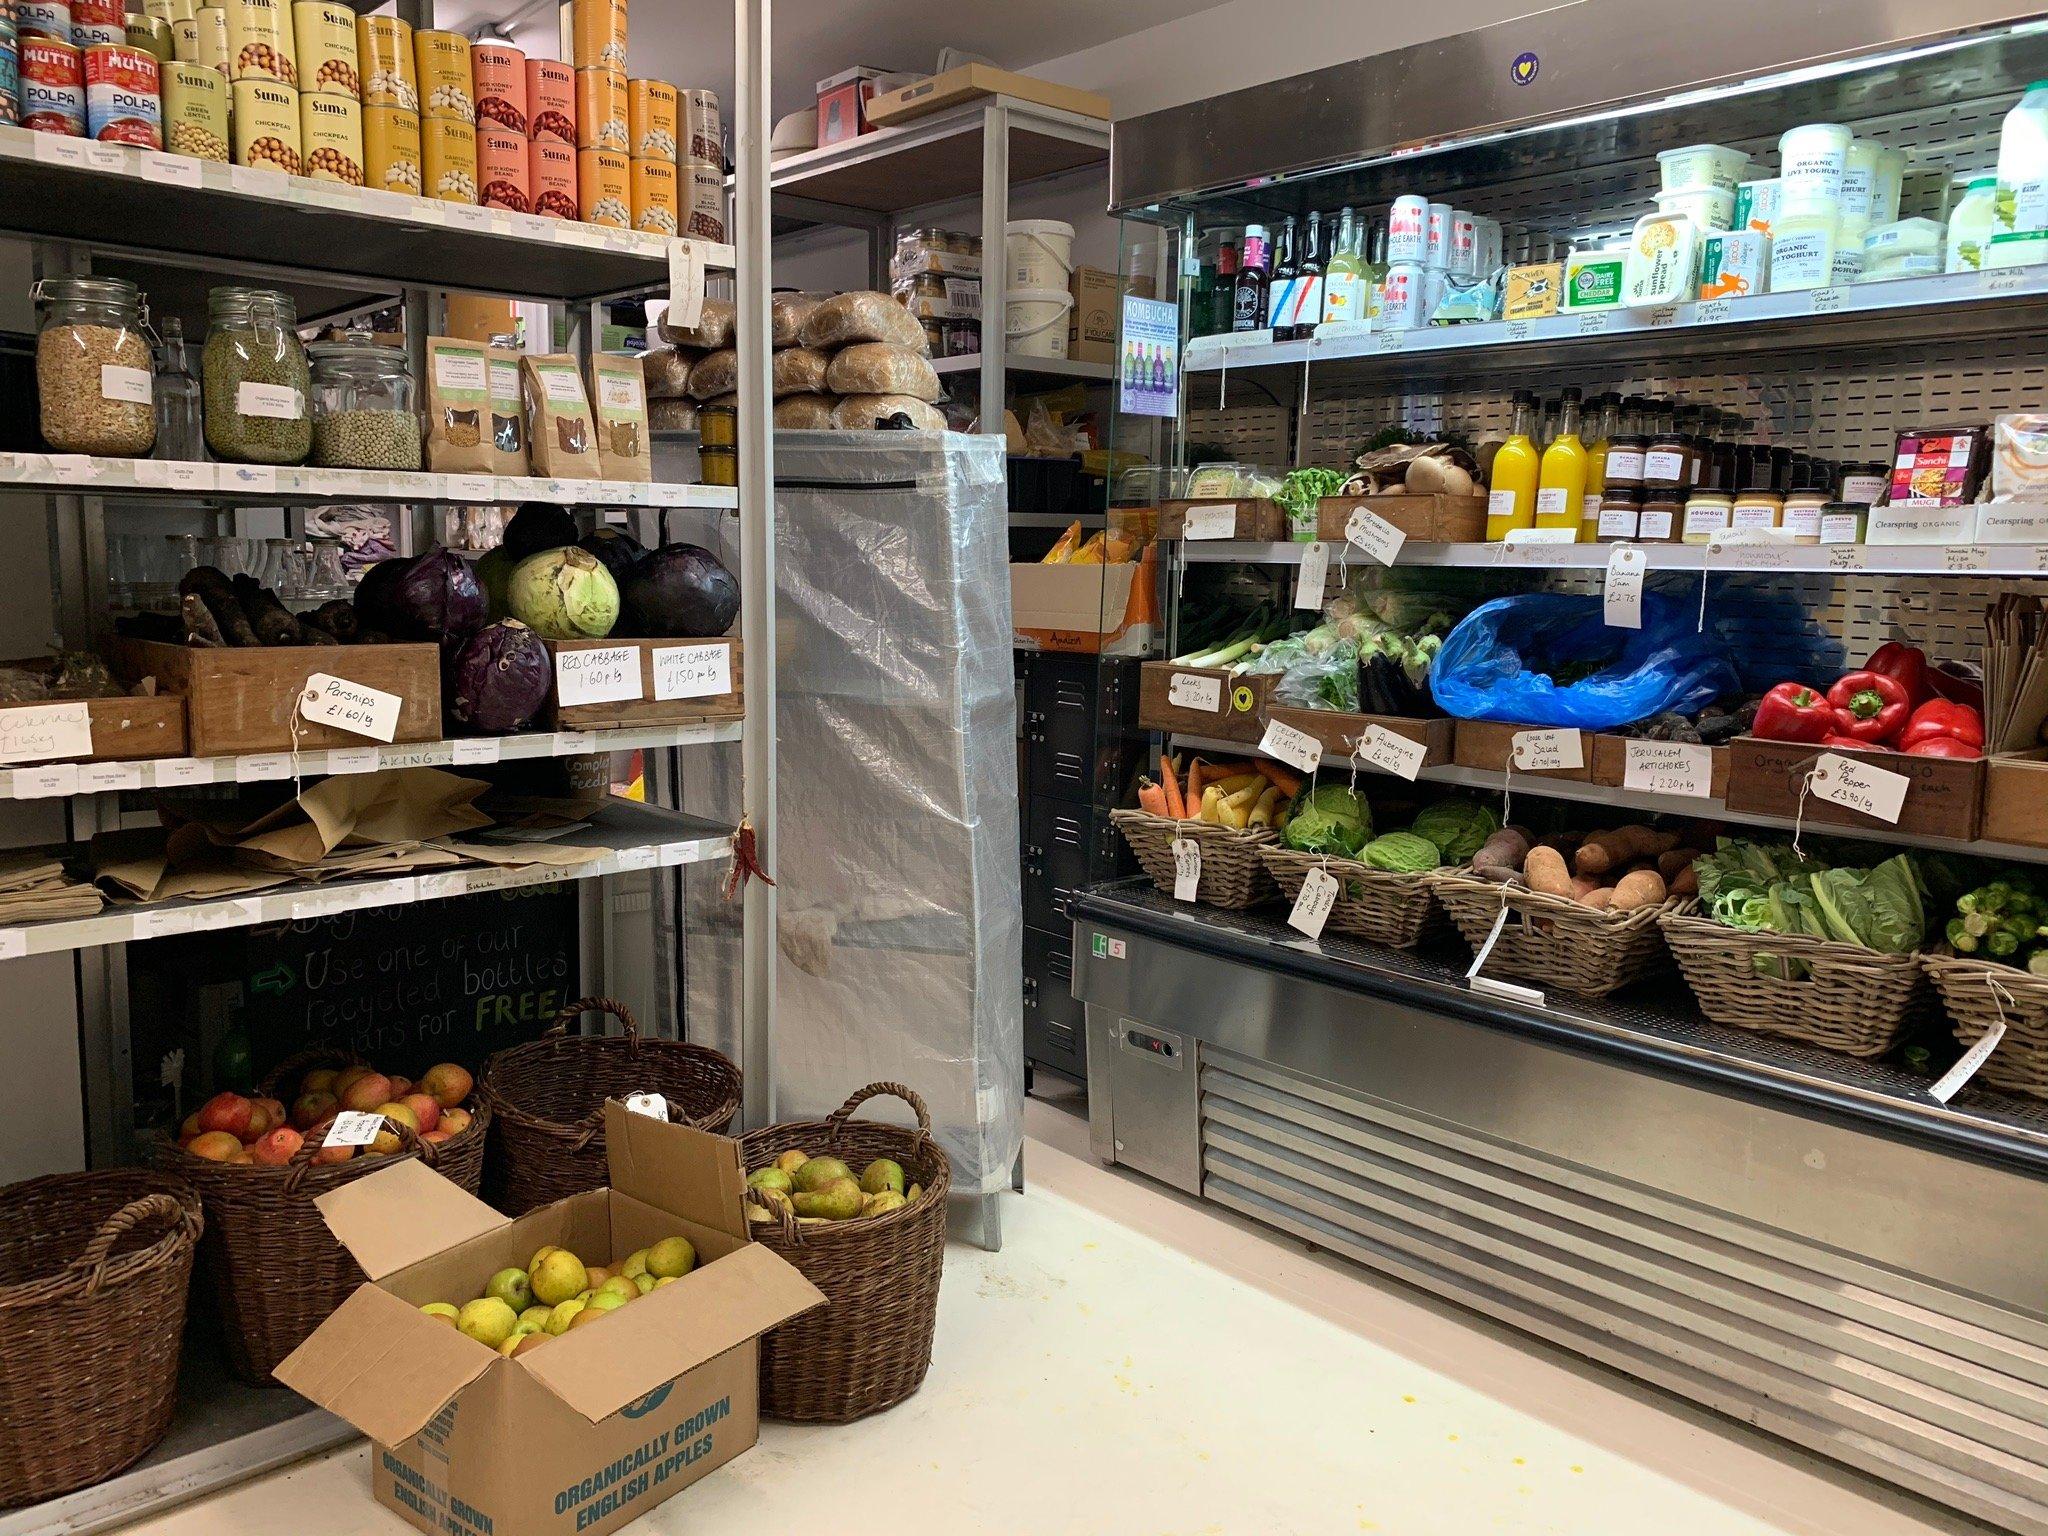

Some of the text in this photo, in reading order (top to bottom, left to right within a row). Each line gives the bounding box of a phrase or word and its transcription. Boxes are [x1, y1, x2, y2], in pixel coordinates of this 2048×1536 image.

[17, 5, 55, 21] OLPA
[324, 10, 354, 29] Suma
[126, 24, 154, 37] uma
[24, 49, 75, 69] MUTTI
[108, 52, 156, 78] MUTTI
[480, 53, 511, 66] Suma
[176, 72, 214, 90] Suma
[540, 68, 569, 82] Suma
[27, 88, 76, 106] POLPA
[254, 88, 290, 105] Suma
[649, 88, 674, 102] Suma
[112, 94, 156, 112] POLPA
[312, 100, 347, 116] Suma
[254, 120, 291, 130] CHICKPEAS
[313, 131, 348, 141] CHICKPEAS
[444, 125, 473, 142] Suma
[487, 138, 518, 151] Suma
[542, 148, 570, 162] Suma
[598, 156, 626, 170] Suma
[645, 166, 672, 179] Suma
[694, 173, 720, 187] Suma
[1403, 234, 1422, 244] EARTH
[1427, 243, 1440, 251] RTH
[1776, 244, 1808, 255] ORGANIC
[1782, 251, 1819, 261] YOGHURT
[1651, 250, 1663, 295] sunflower
[1658, 263, 1668, 295] spread
[1580, 289, 1611, 298] CHEDDAR
[1126, 300, 1174, 322] KOMBUCHA
[1389, 303, 1407, 311] EARTH
[1917, 456, 1947, 465] Sanchi
[1875, 520, 1918, 529] Clearspring
[1986, 516, 2034, 526] Clearspring
[1610, 567, 1640, 577] Banana
[1609, 578, 1630, 588] Jam
[562, 650, 630, 671] RED CABBAGE
[658, 648, 723, 667] WHITE CABBAGE
[1181, 676, 1202, 689] Leeks
[325, 680, 375, 707] Parsnips
[1276, 726, 1304, 743] CELERY
[1526, 734, 1542, 743] Loose
[1376, 733, 1414, 760] Aubergine
[1534, 743, 1560, 754] Salad
[1630, 747, 1682, 758] JERUSALEM
[380, 752, 434, 767] AKING
[1639, 761, 1691, 773] ARTICHOKES
[1838, 760, 1855, 774] Red
[1838, 772, 1871, 790] Pepper
[1308, 885, 1325, 916] Cabbage
[1114, 942, 1122, 954] 5
[305, 949, 364, 990] Use
[377, 943, 431, 975] one
[477, 925, 524, 953] our
[305, 951, 568, 1031] recycled bottles
[418, 1008, 456, 1040] for
[553, 1394, 731, 1516] ORGANICALLY GROWN
[575, 1433, 714, 1533] ENGLISH APPLES
[382, 1450, 493, 1536] ORGANICALLY GROWN
[394, 1480, 436, 1524] ENGLISH
